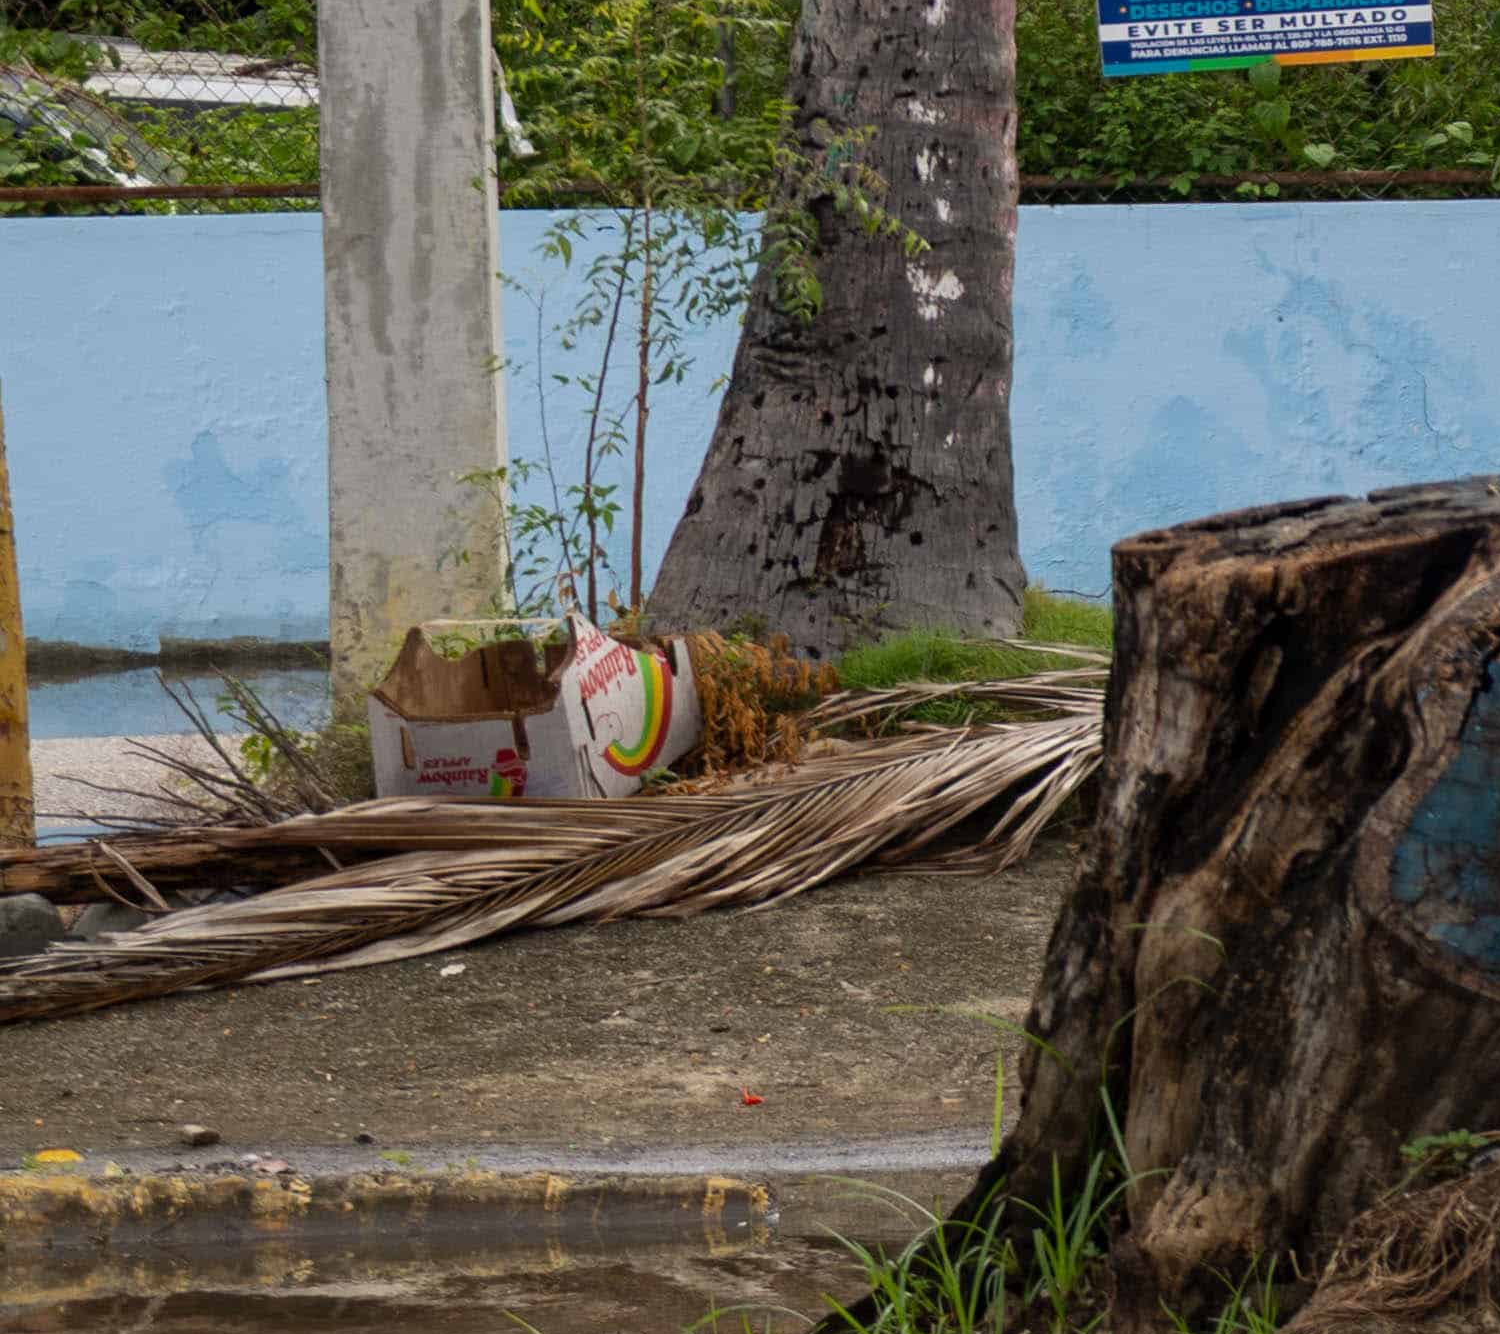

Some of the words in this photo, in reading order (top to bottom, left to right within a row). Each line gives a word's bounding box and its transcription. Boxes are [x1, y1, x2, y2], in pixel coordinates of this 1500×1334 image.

[1127, 21, 1204, 38] EVITE
[1217, 18, 1265, 33] SER
[1280, 8, 1407, 28] MULTADO
[1130, 47, 1163, 60] PARA
[1163, 44, 1228, 57] DENUNCIAS
[1228, 40, 1272, 54] LLAMAR
[1274, 39, 1289, 50] AL
[1363, 34, 1386, 45] EXT.
[578, 642, 637, 701] Rainbow
[415, 769, 489, 787] Rainbow
